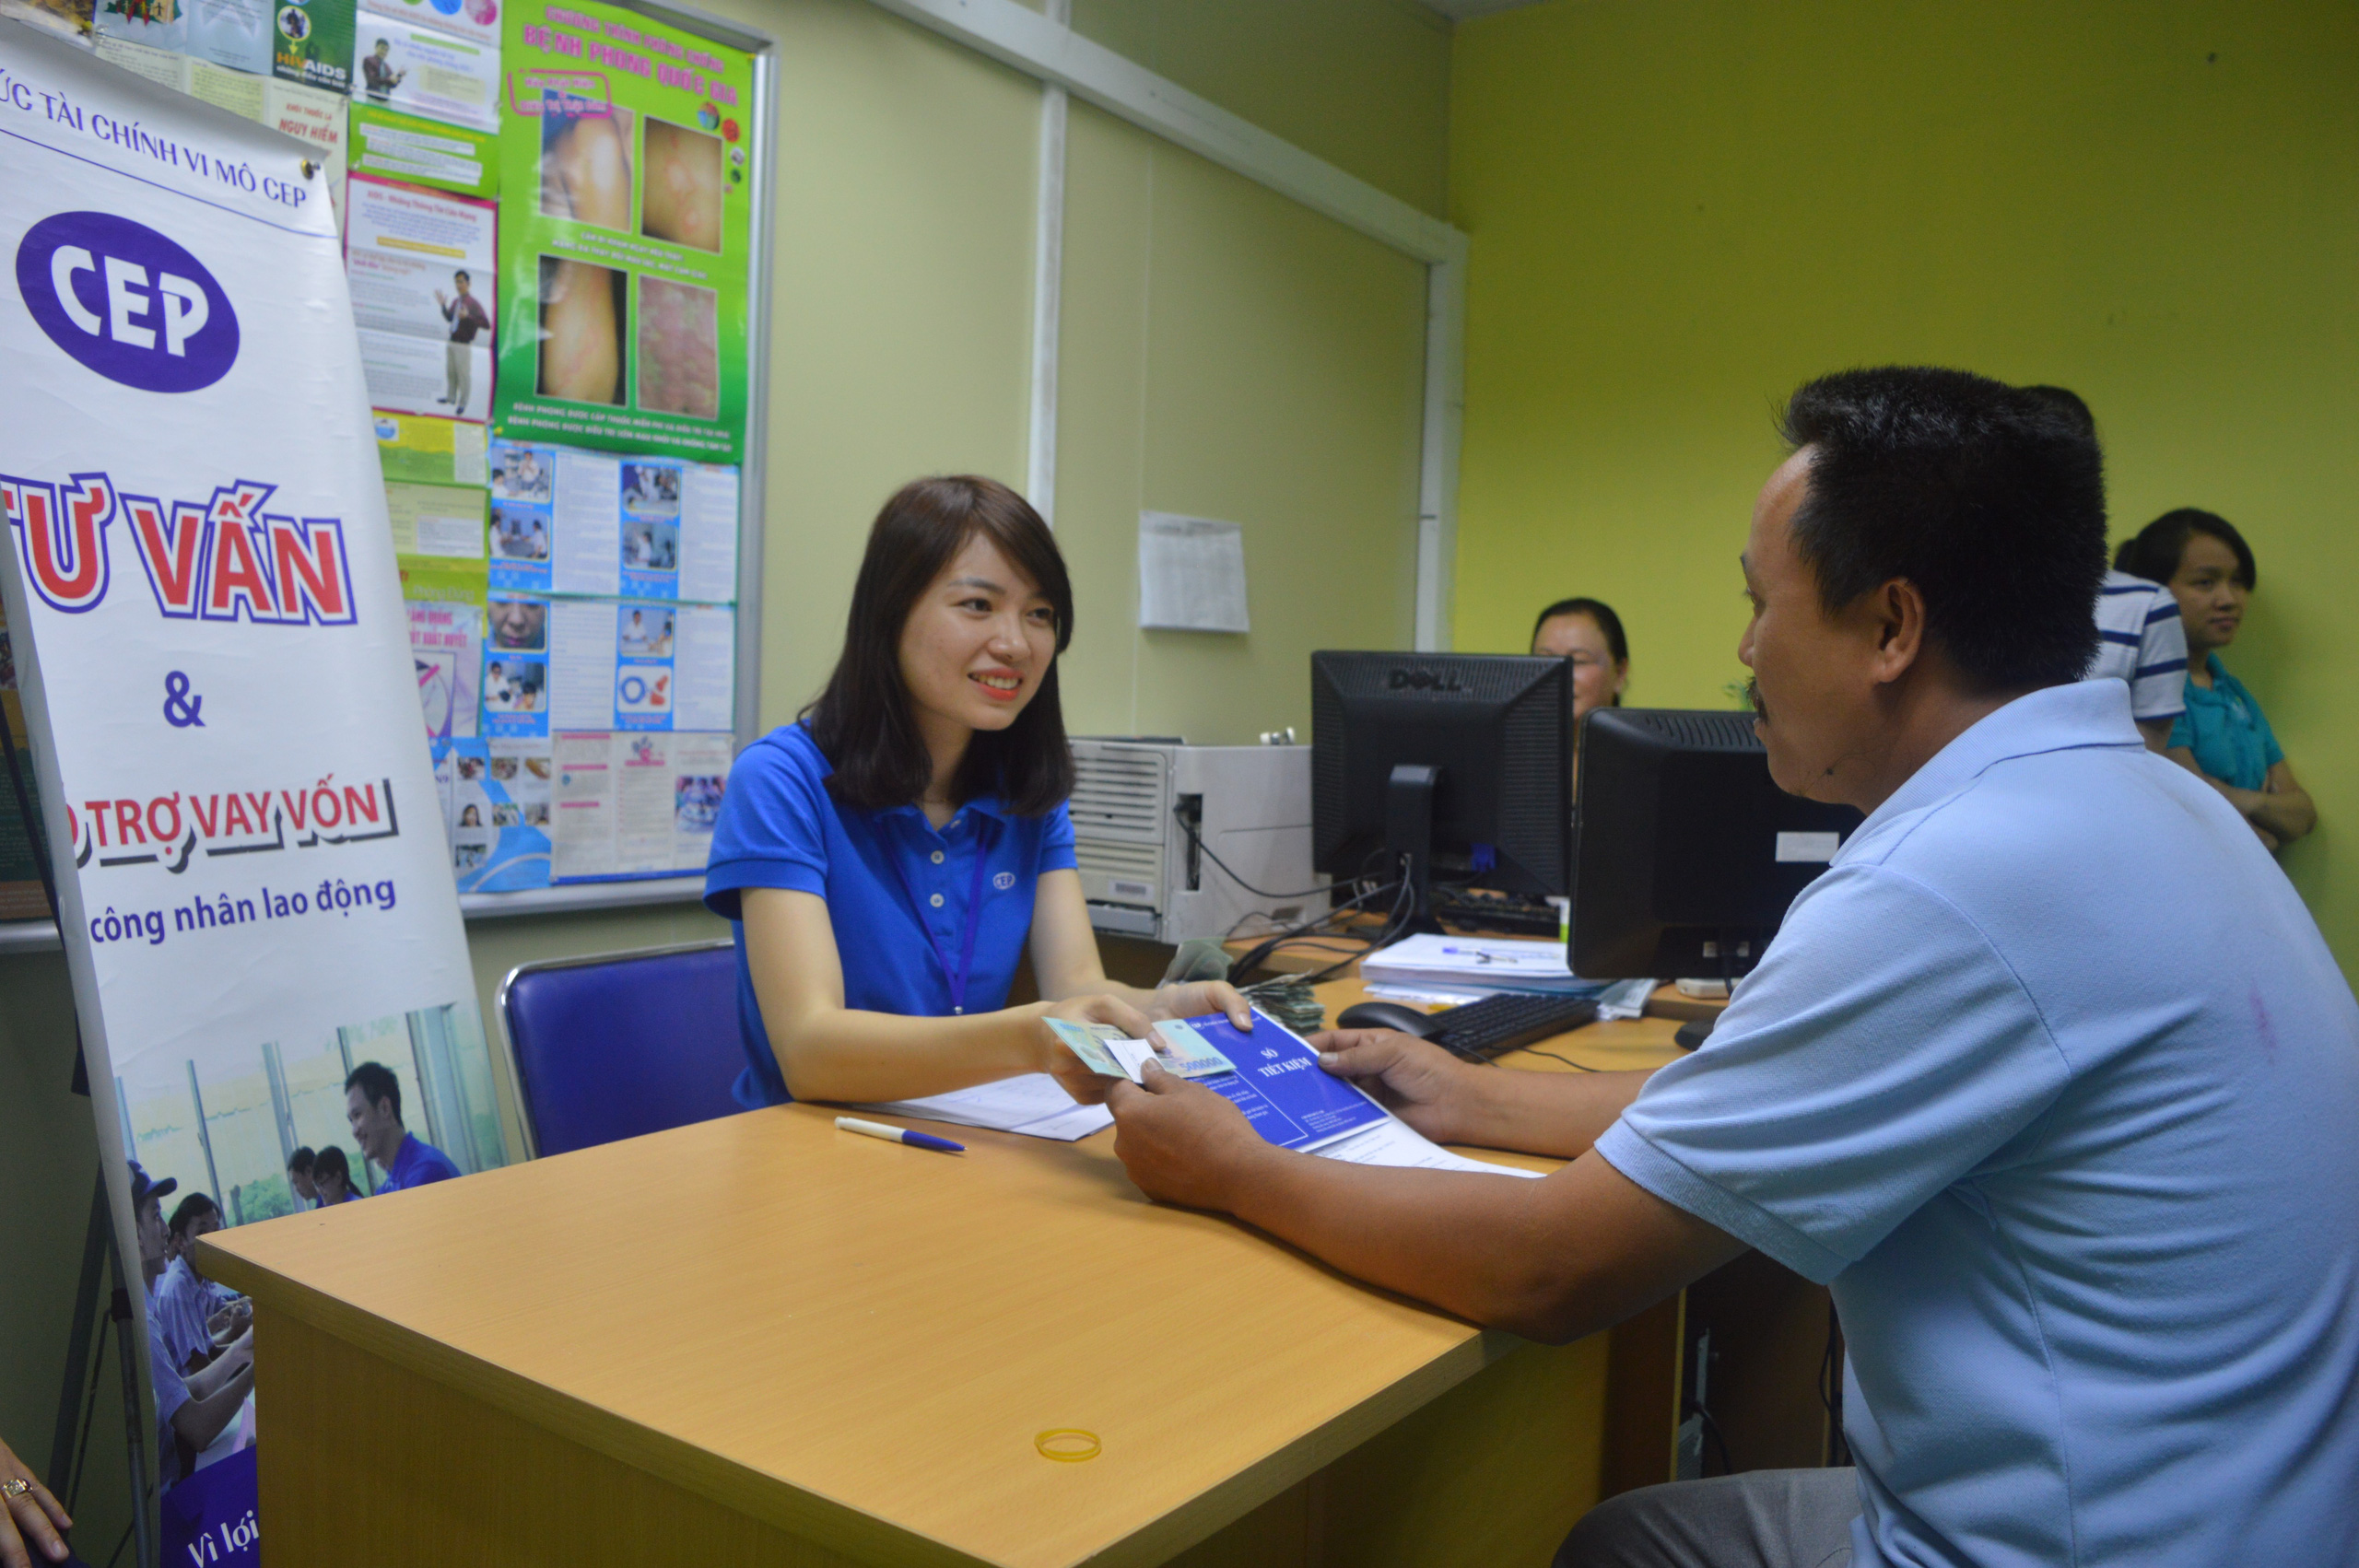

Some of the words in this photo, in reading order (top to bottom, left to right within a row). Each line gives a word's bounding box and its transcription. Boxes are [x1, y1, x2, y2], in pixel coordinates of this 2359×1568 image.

[304, 59, 346, 80] AIDS
[523, 24, 581, 58] BỆNH
[590, 41, 651, 77] PHONG
[658, 63, 705, 95] QUỐC
[710, 80, 738, 106] GIA
[604, 22, 640, 44] TRÌNH
[644, 34, 683, 59] PHÒNG
[687, 49, 723, 73] CHỐNG
[39, 91, 84, 131] TÀI
[92, 114, 178, 166] CHÍNH
[183, 147, 208, 176] VI
[216, 162, 256, 192] MÔ
[264, 177, 307, 207] CEP
[279, 119, 308, 136] NGUY
[310, 123, 337, 143] HIỂM
[51, 245, 209, 357] CEP
[0, 472, 117, 614] Ư
[118, 478, 358, 626] VẤN
[163, 671, 206, 727] &
[1390, 669, 1461, 691] DELL
[85, 791, 182, 856] TRỢ
[189, 790, 272, 838] VAY
[281, 773, 379, 830] VỐN
[994, 874, 1013, 886] CEP
[90, 907, 166, 945] công
[174, 892, 256, 932] nhân
[262, 887, 309, 919] lao
[316, 879, 396, 918] động
[1180, 1056, 1224, 1073] 500000
[1258, 1063, 1285, 1077] TIẾT
[1282, 1056, 1312, 1071] KIỆM
[187, 1532, 218, 1568] Vì
[220, 1509, 260, 1553] lợi
